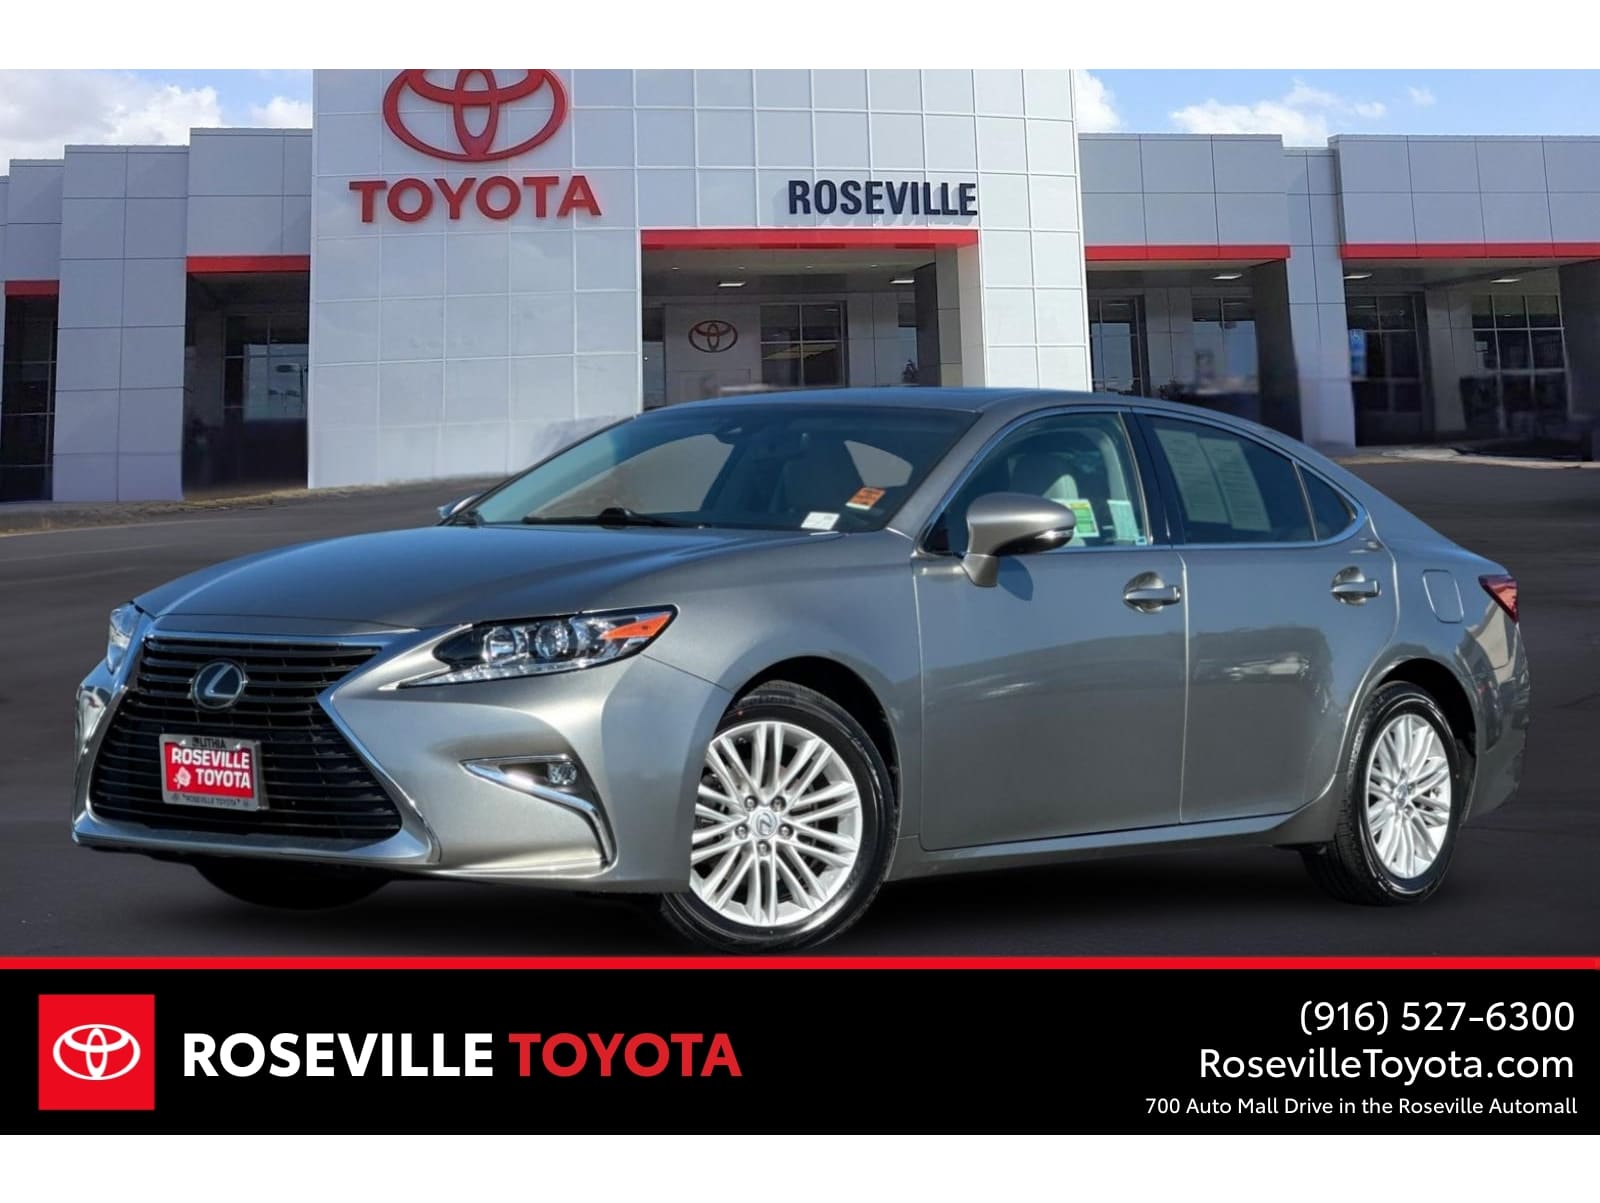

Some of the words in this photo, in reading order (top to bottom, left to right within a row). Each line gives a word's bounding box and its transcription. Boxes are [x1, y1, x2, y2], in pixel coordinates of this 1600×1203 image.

[350, 175, 601, 223] TOYOTA
[788, 179, 979, 218] ROSEVILLE
[171, 747, 250, 769] ROSEVILLE
[196, 768, 251, 789] TOYOTA
